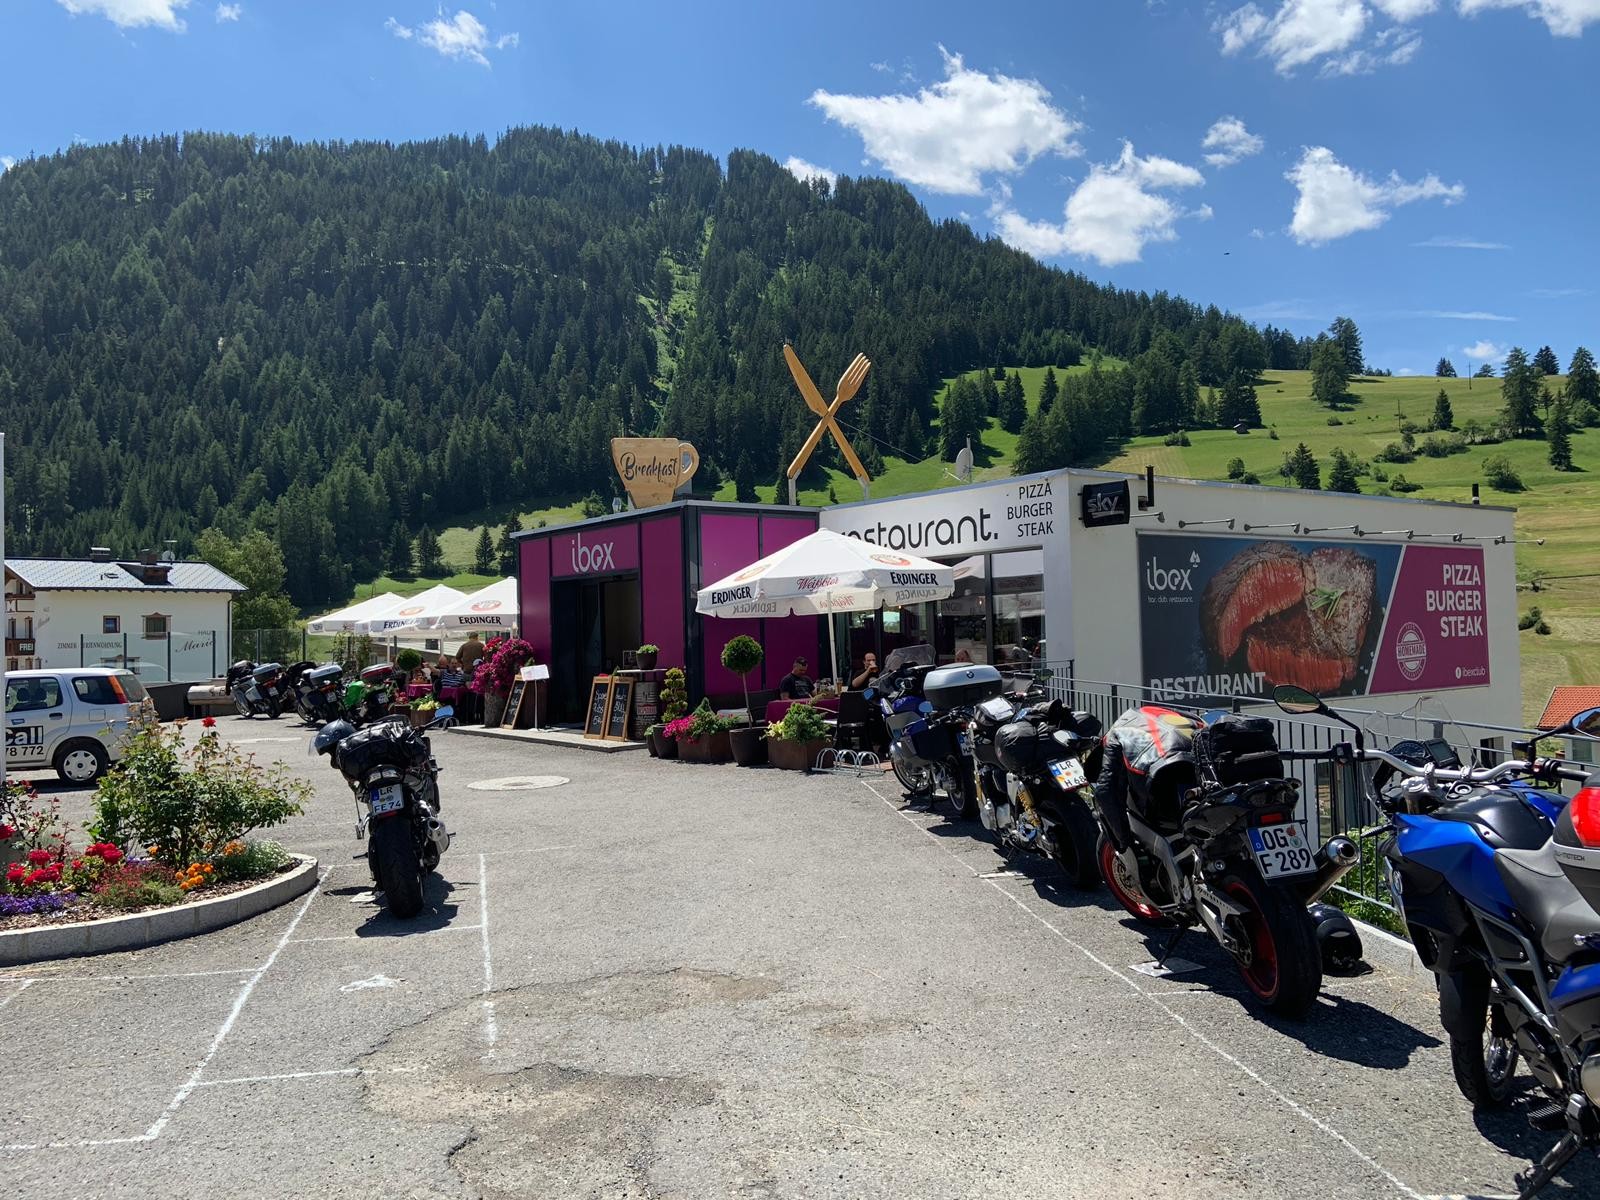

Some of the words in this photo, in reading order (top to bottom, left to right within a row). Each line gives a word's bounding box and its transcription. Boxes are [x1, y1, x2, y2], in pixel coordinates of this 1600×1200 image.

[620, 451, 679, 482] Breakfast
[1018, 481, 1053, 499] PIZZA
[1007, 502, 1053, 520] BURGER
[1087, 492, 1119, 514] sky
[841, 508, 998, 551] staurant.
[1017, 520, 1054, 538] STEAK
[571, 532, 616, 574] ibex
[890, 571, 939, 586] ERDINGER
[1146, 556, 1193, 591] ibex
[1443, 564, 1481, 586] PIZZA
[711, 586, 752, 605] ERDINGER
[1426, 590, 1482, 612] BURGER
[458, 616, 502, 625] ERDINGER
[1440, 615, 1483, 638] STEAK
[19, 643, 34, 651] FREI
[1397, 644, 1426, 656] HOMEMADE
[1150, 671, 1266, 702] RESTAURANT
[21, 745, 44, 756] 772
[1059, 760, 1074, 770] LR
[380, 786, 393, 795] LR
[1064, 779, 1073, 787] H
[374, 803, 387, 813] FE
[388, 800, 401, 809] 74
[1261, 827, 1289, 850] OG
[1259, 853, 1273, 874] F
[1275, 848, 1311, 872] 289
